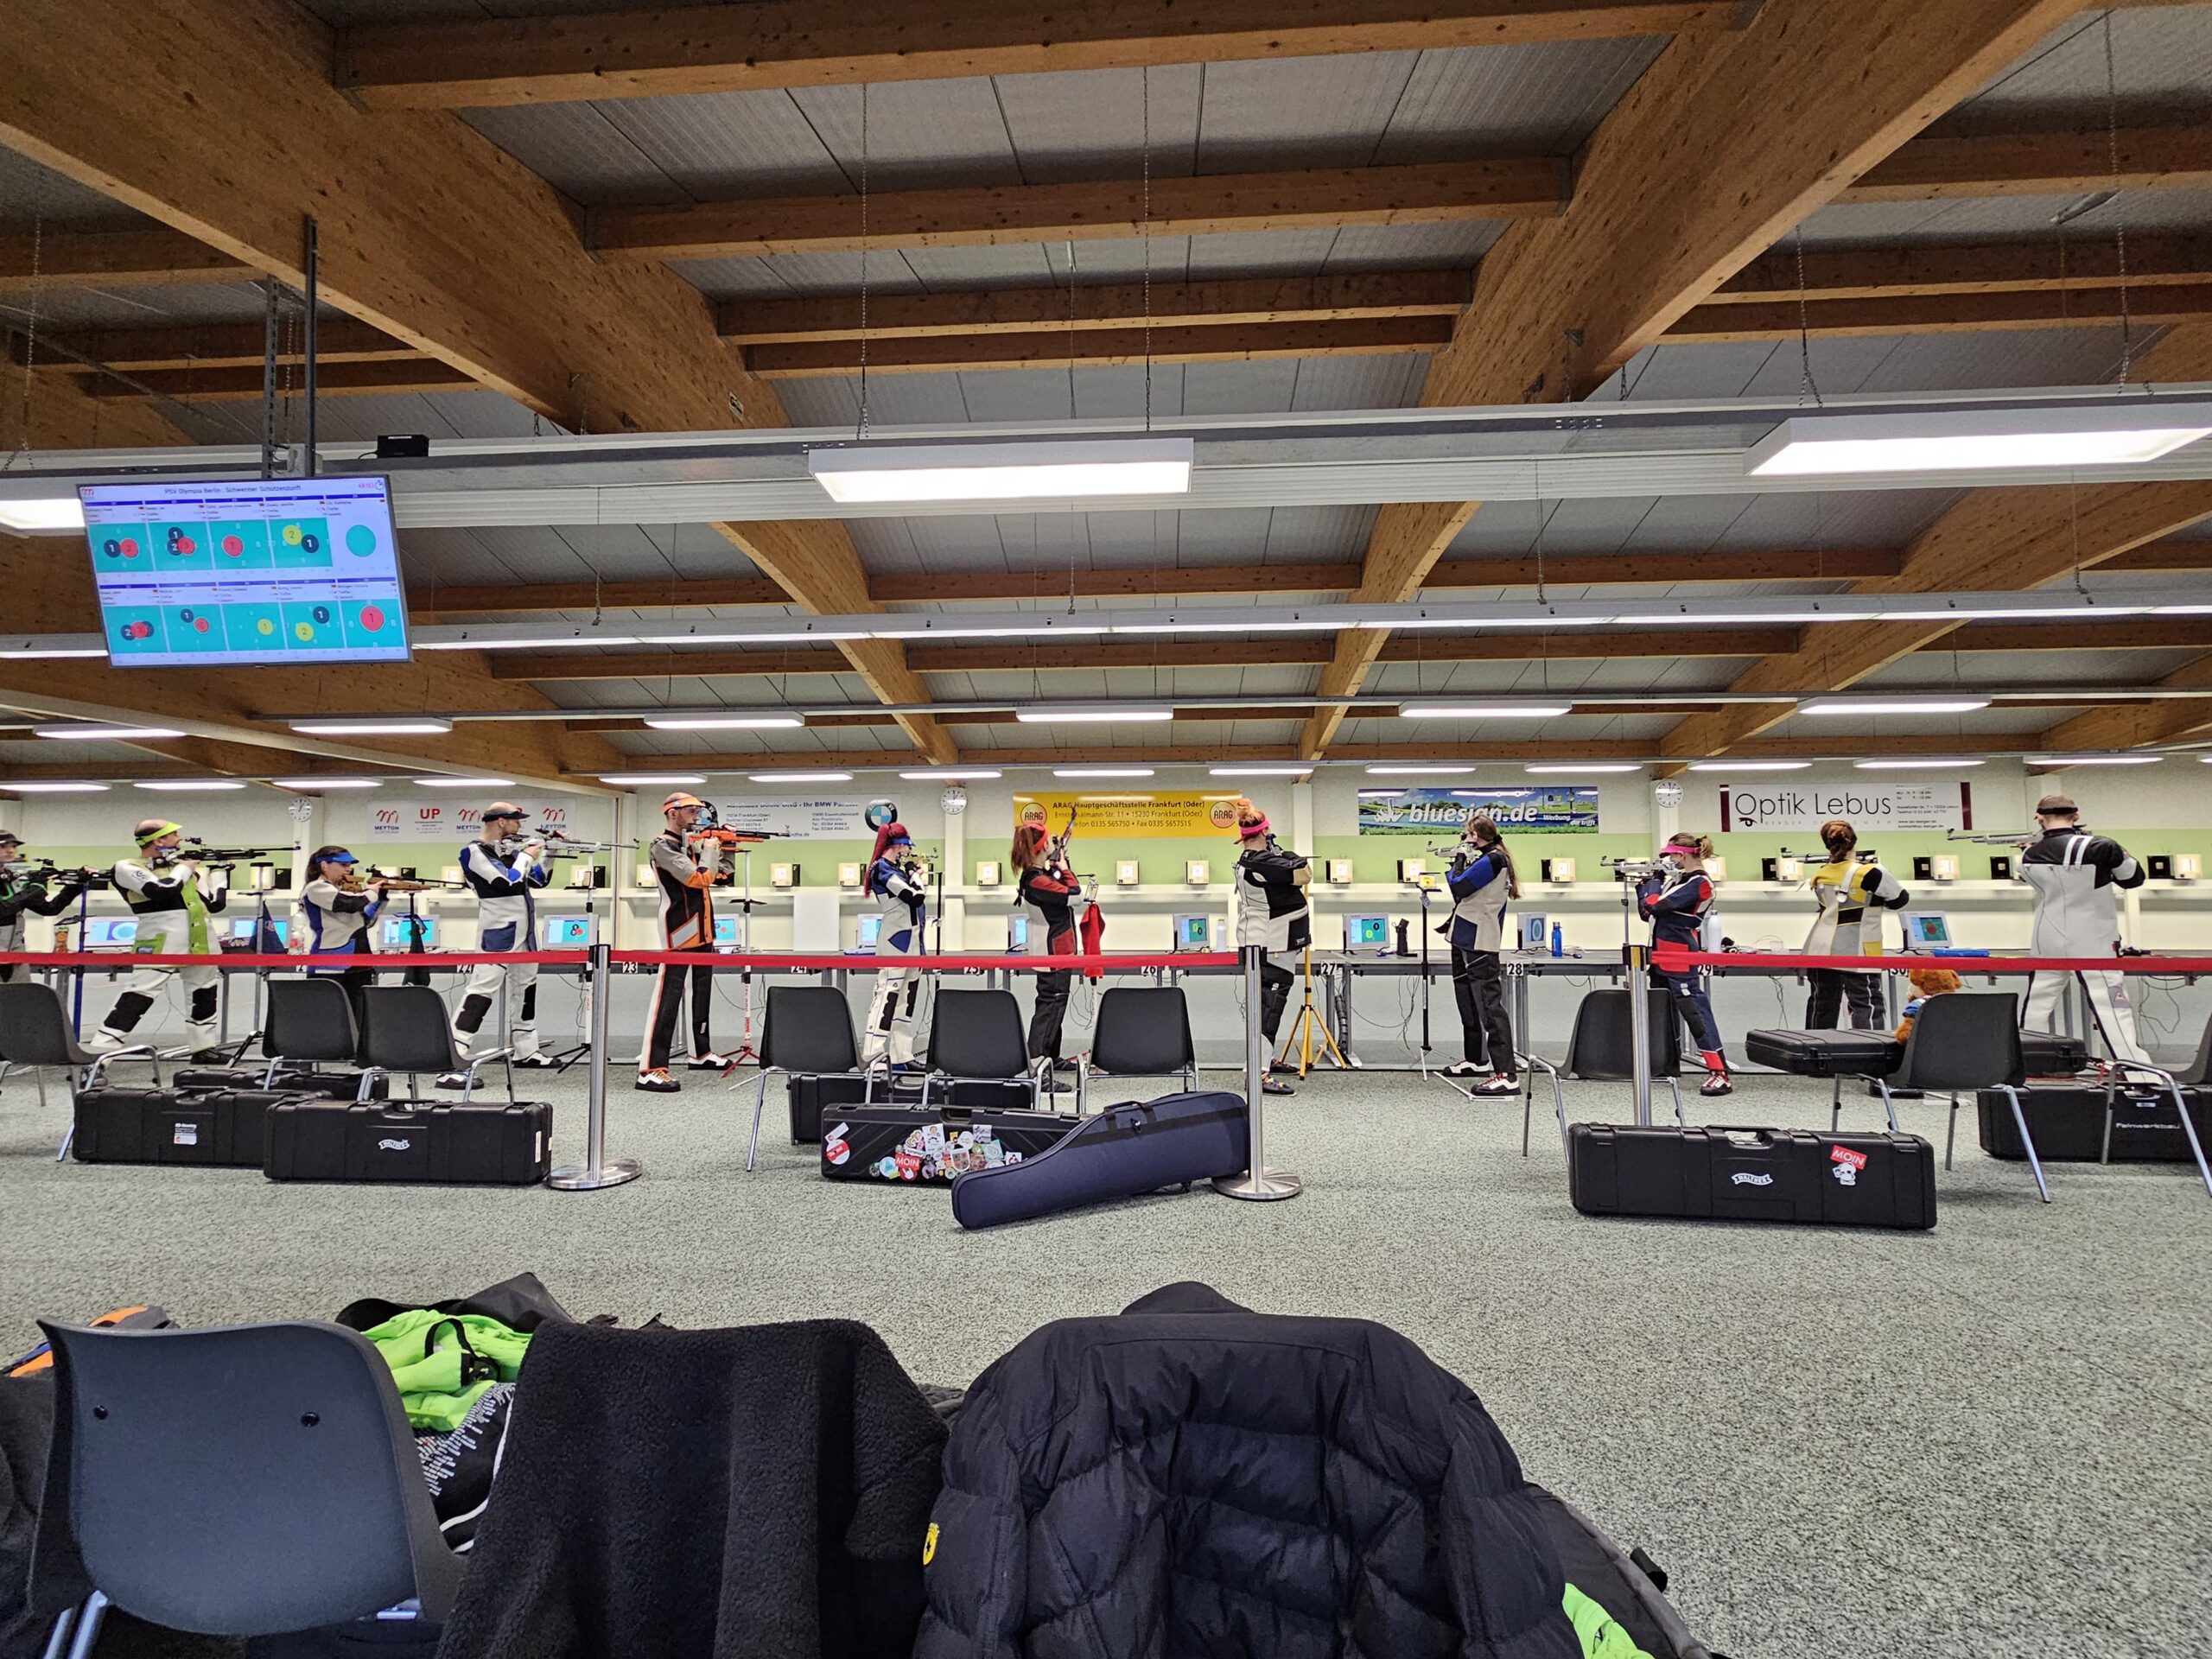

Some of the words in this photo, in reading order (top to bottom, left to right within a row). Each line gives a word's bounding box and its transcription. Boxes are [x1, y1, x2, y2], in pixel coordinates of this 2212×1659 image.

[1074, 801, 1147, 810] Hauptgeschäftsstelle
[1183, 800, 1205, 809] (Oder)
[1735, 792, 1806, 823] Optik
[1815, 791, 1891, 816] Lebus
[420, 808, 441, 819] UP
[1024, 811, 1043, 821] ARAG
[1213, 810, 1233, 820] ARAG
[1542, 814, 1572, 823] Werbung
[1581, 818, 1596, 827] trifft
[623, 962, 637, 973] 23
[1321, 963, 1336, 975] 27
[1508, 963, 1522, 976] 28
[1698, 964, 1712, 976] 29
[895, 1157, 920, 1167] MOIN
[1833, 1148, 1865, 1166] MOIN
